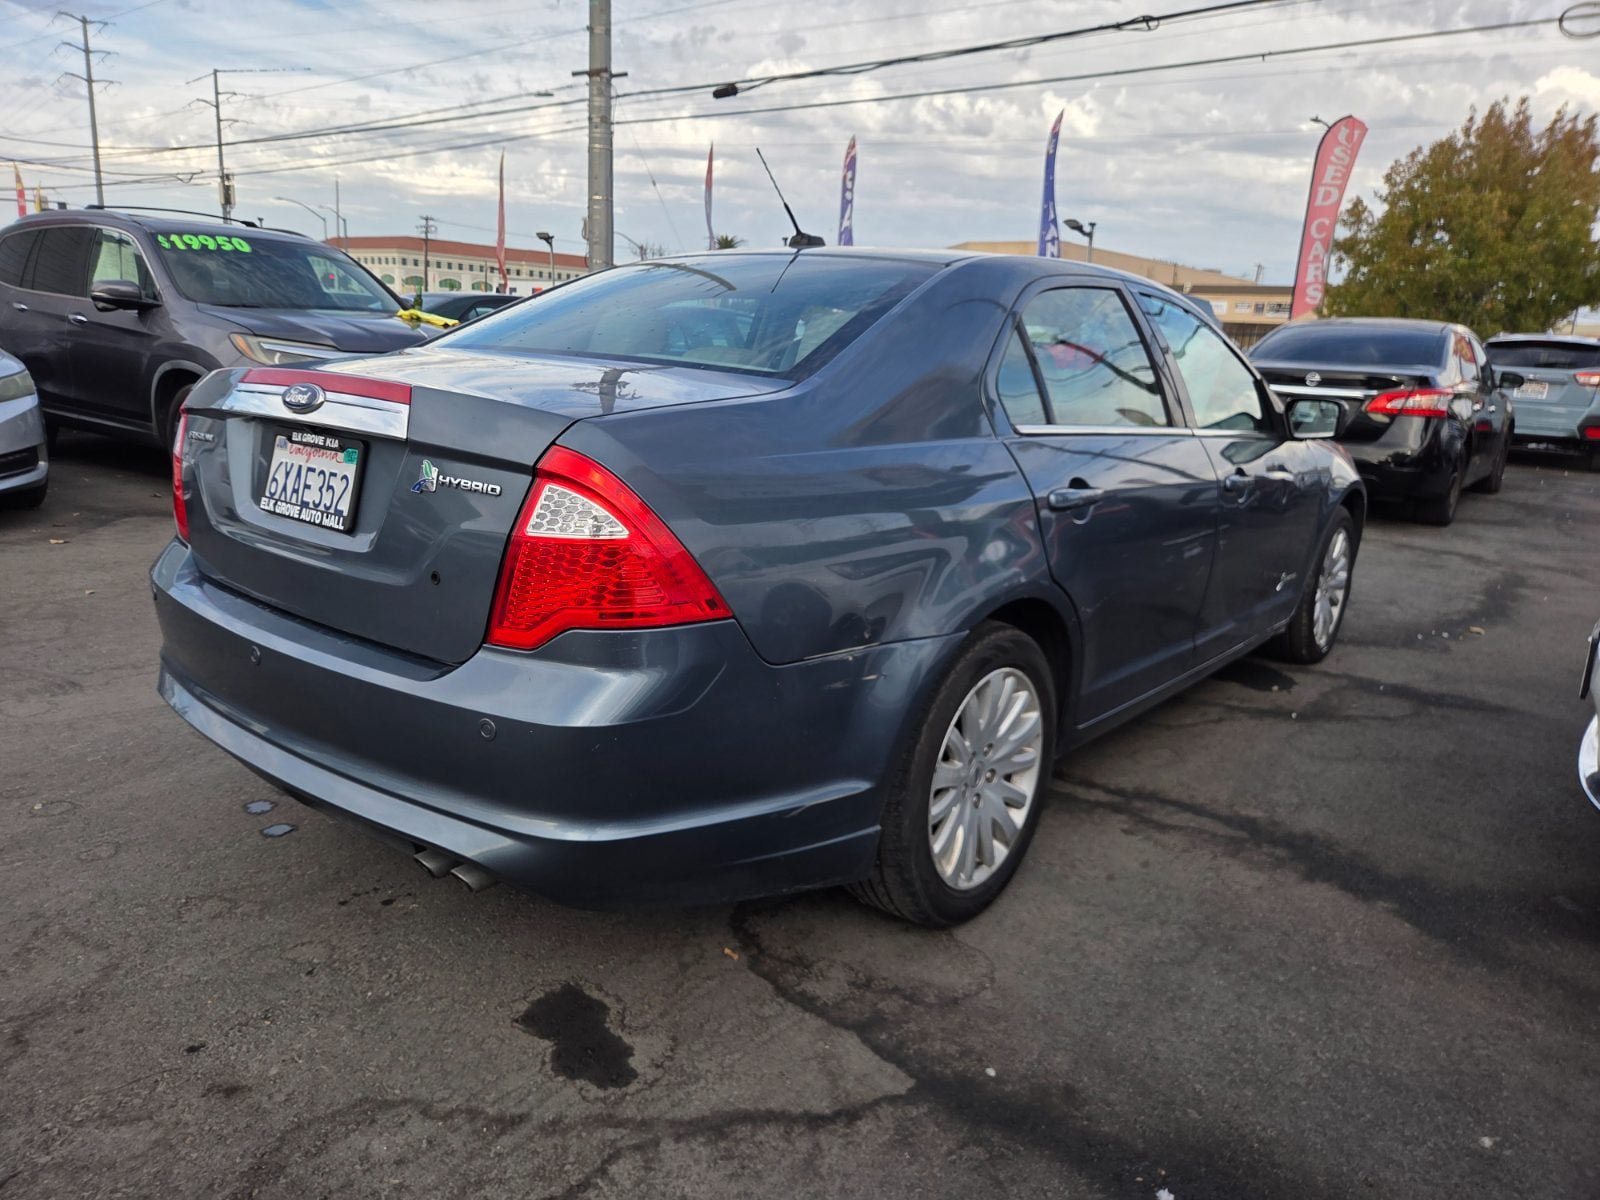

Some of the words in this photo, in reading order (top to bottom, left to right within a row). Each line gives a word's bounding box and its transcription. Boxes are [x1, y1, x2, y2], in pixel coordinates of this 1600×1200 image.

[1314, 126, 1360, 208] USED
[157, 233, 252, 253] $19950
[1305, 217, 1330, 305] CARS
[288, 444, 344, 463] California
[291, 432, 302, 442] ELK
[302, 433, 325, 446] GROVE
[325, 437, 340, 448] KIA
[268, 461, 350, 517] 6XAE352
[438, 474, 502, 496] HYBRID
[260, 497, 276, 512] ELK
[275, 500, 300, 518] GROVE
[300, 506, 321, 524] AUTO
[322, 512, 344, 530] MALL
